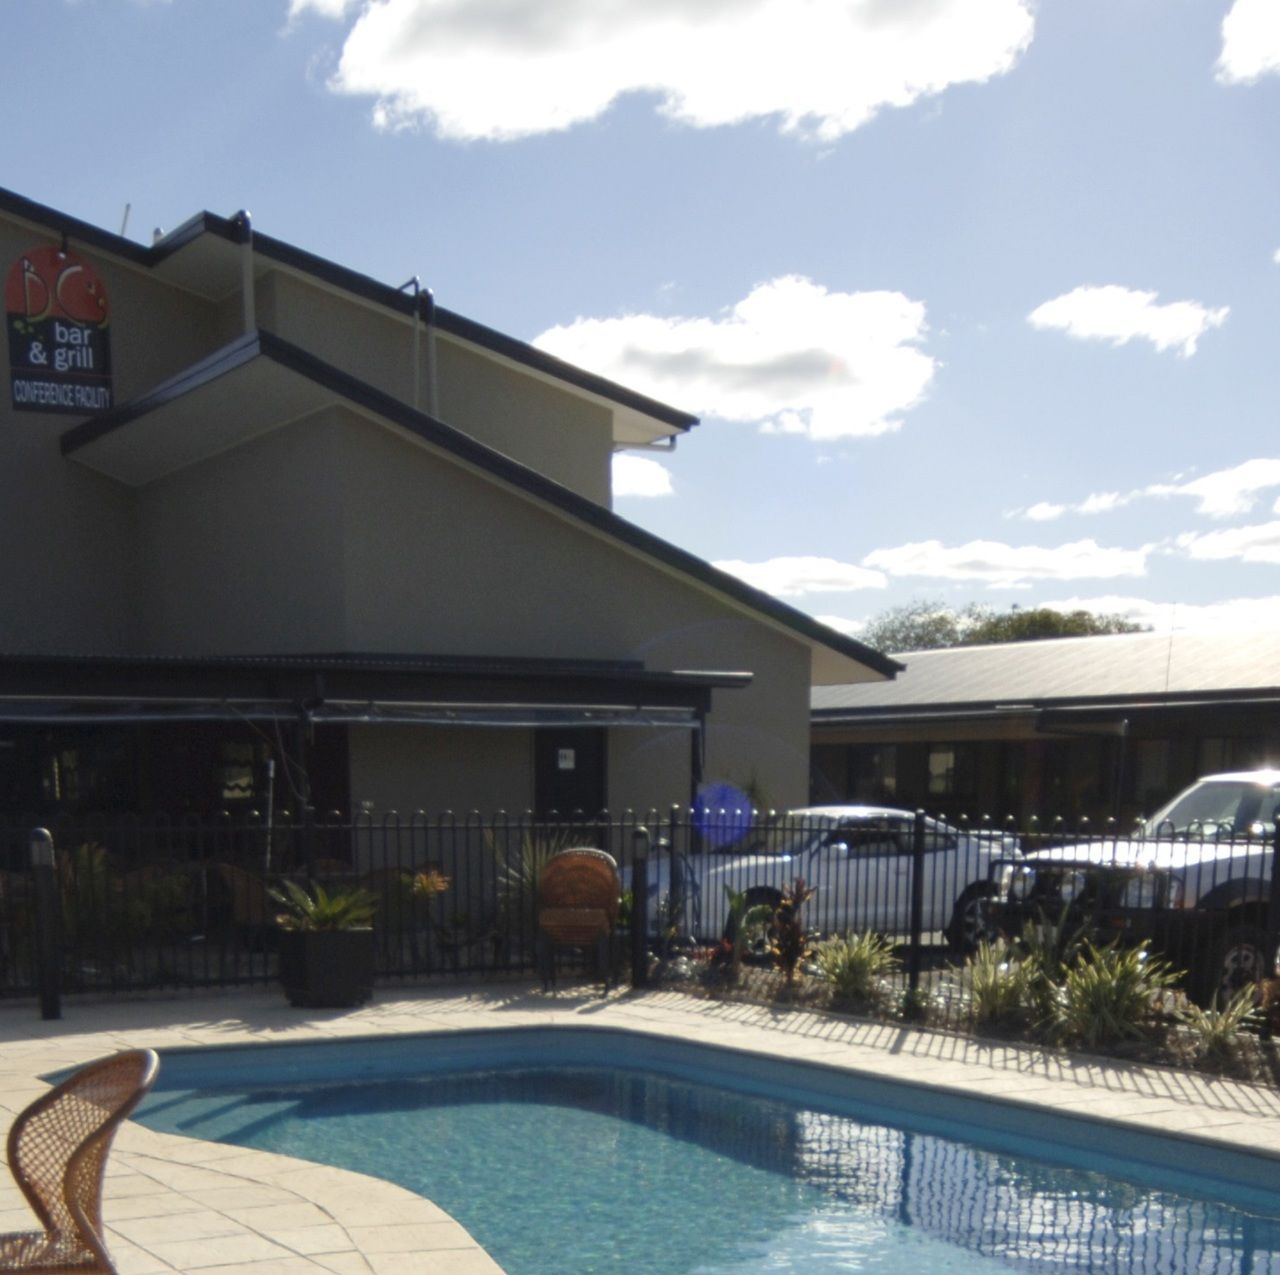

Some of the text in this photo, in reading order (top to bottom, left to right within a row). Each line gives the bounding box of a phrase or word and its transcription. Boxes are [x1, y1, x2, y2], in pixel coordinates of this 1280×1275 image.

[55, 322, 92, 345] bar
[29, 341, 94, 371] & grill
[14, 379, 111, 409] CONFERENCE FACILITY
